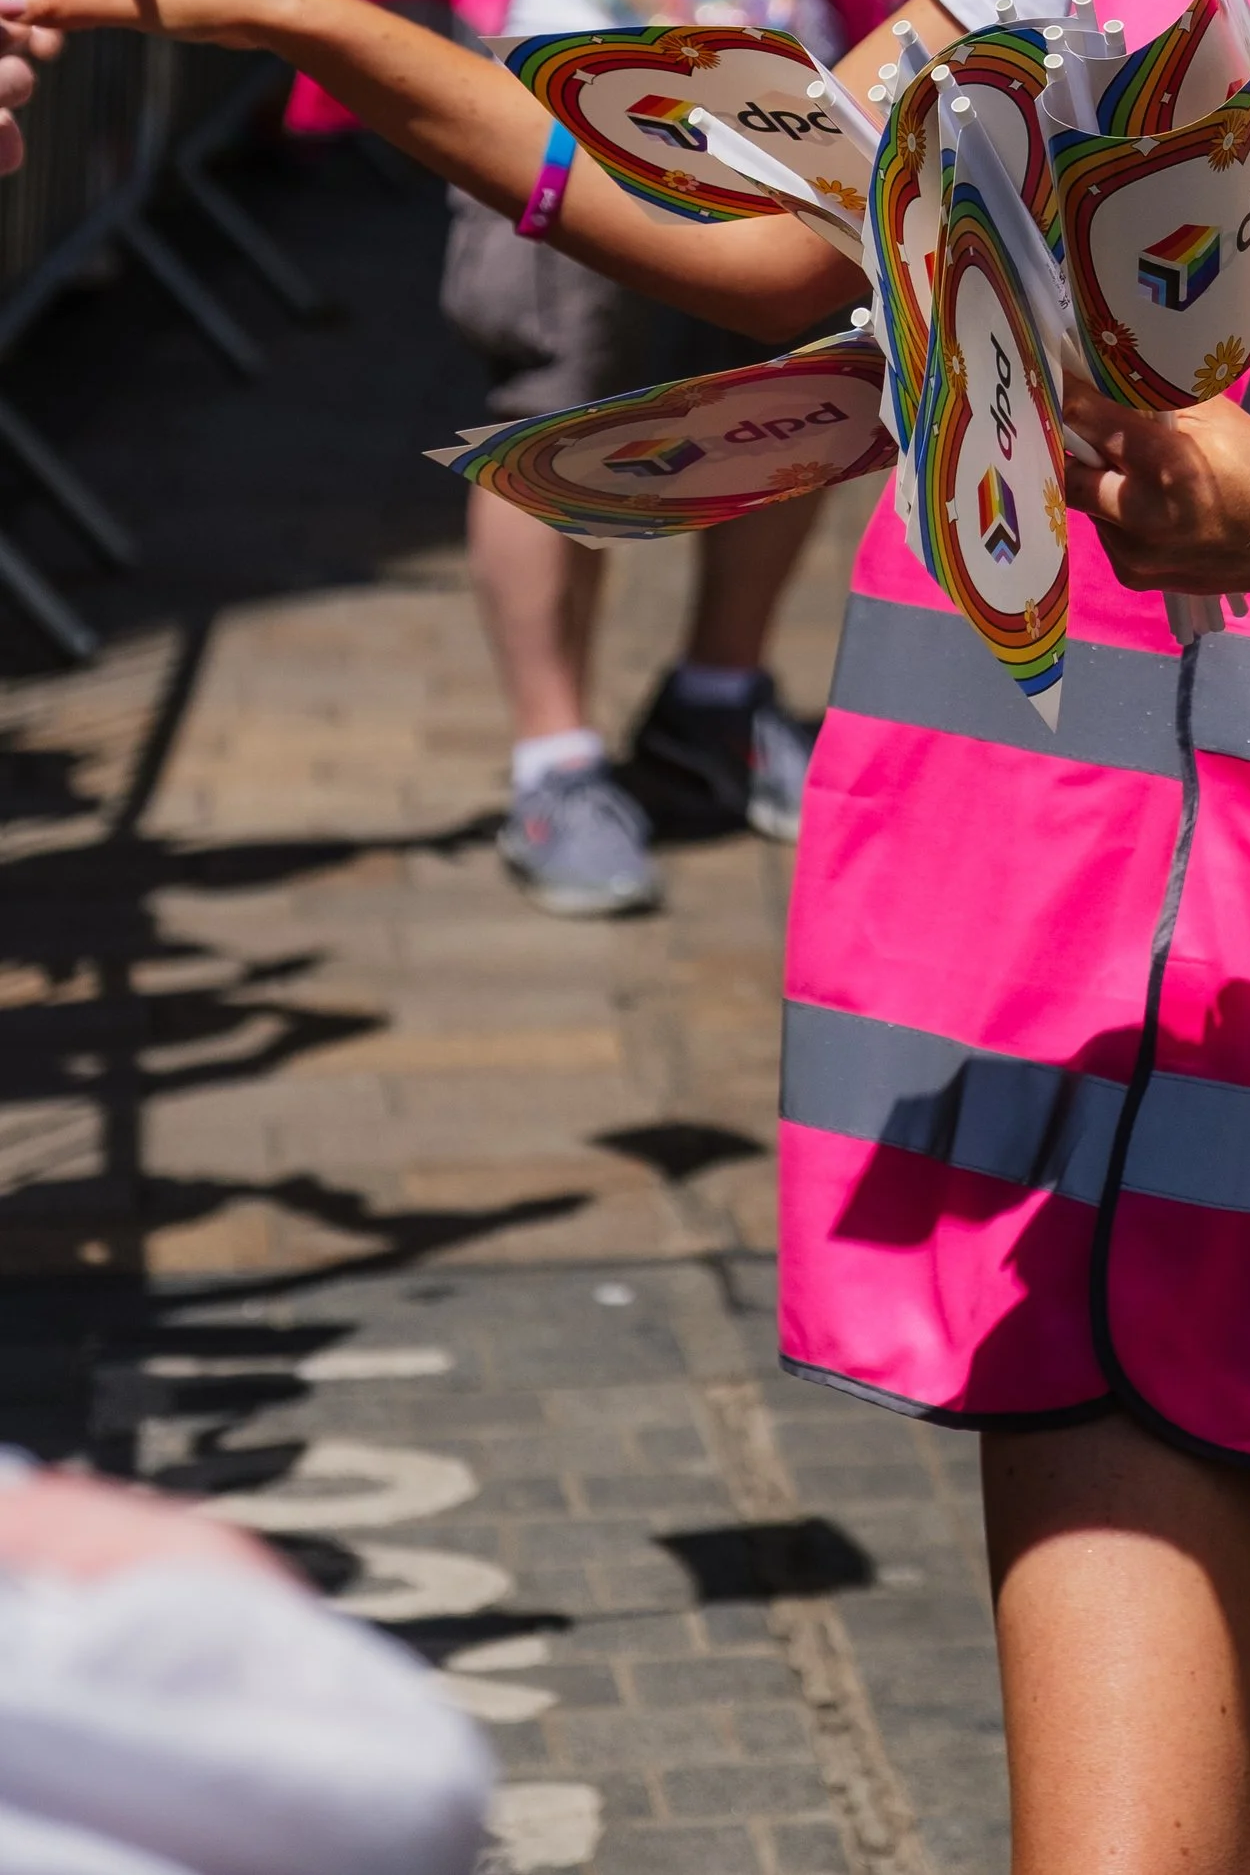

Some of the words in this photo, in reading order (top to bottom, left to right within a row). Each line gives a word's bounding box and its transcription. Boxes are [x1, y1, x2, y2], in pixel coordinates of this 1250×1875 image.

[737, 101, 843, 141] dpd
[990, 331, 1018, 461] dpd
[723, 401, 850, 444] dpd
